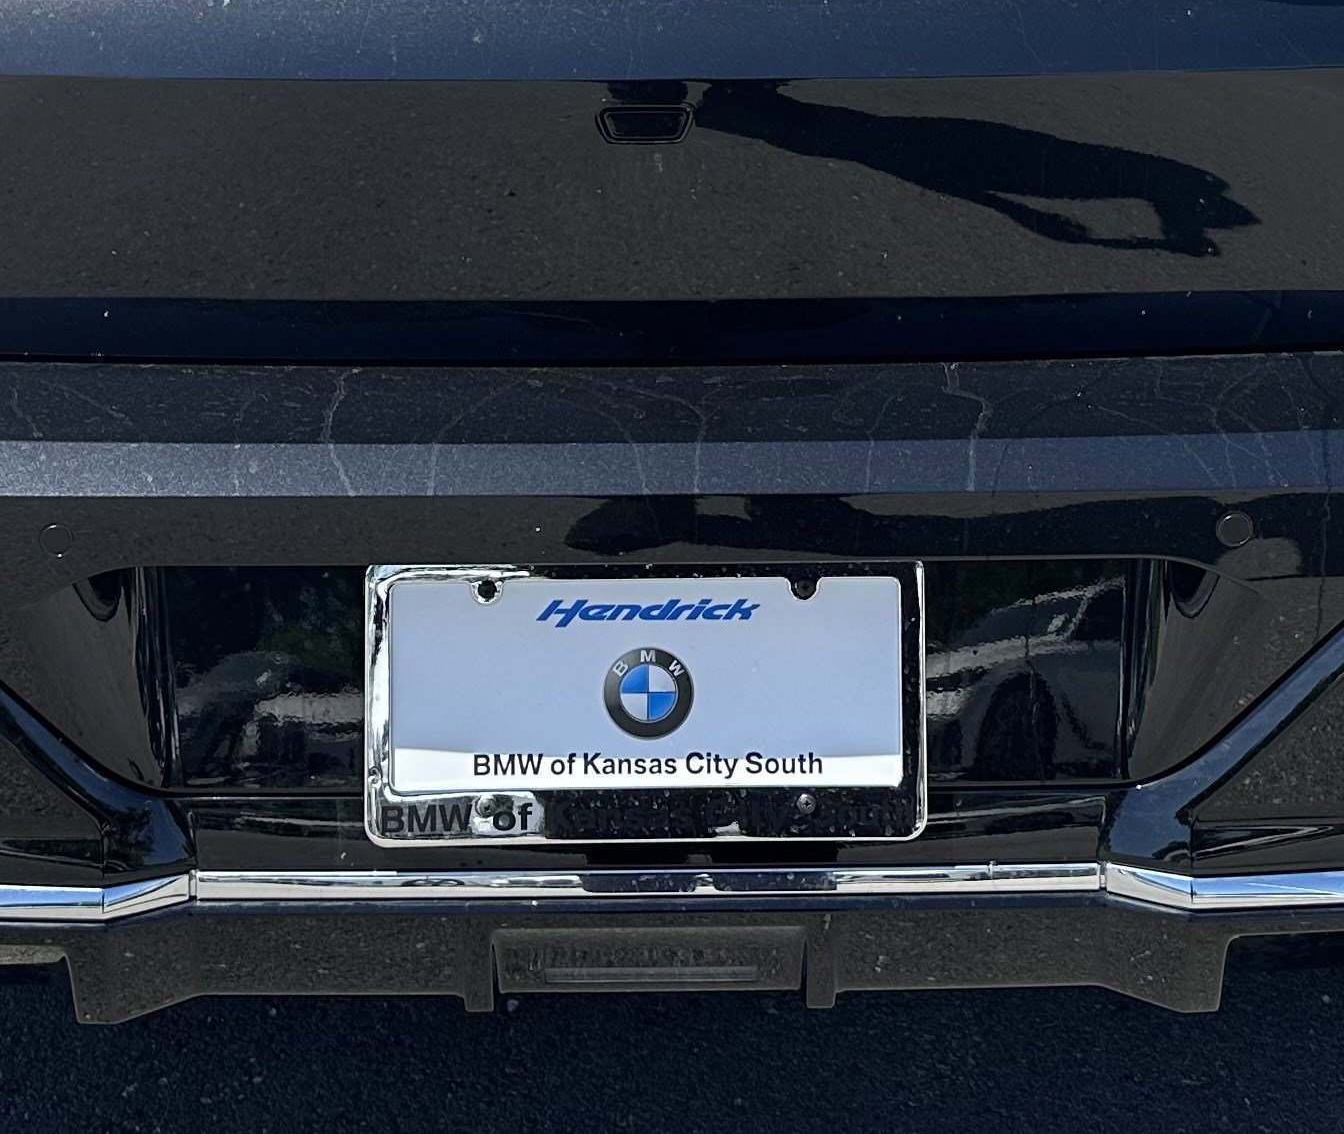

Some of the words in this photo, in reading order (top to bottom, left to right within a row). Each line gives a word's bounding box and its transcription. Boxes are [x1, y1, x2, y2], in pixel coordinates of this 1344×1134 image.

[536, 598, 761, 628] Hendrick
[612, 649, 685, 677] BMW
[473, 752, 544, 776] BMW
[550, 752, 577, 775] of
[583, 752, 677, 775] Kansas
[685, 751, 739, 780] City
[745, 751, 824, 775] South
[381, 803, 473, 833] BMW
[493, 802, 532, 831] of
